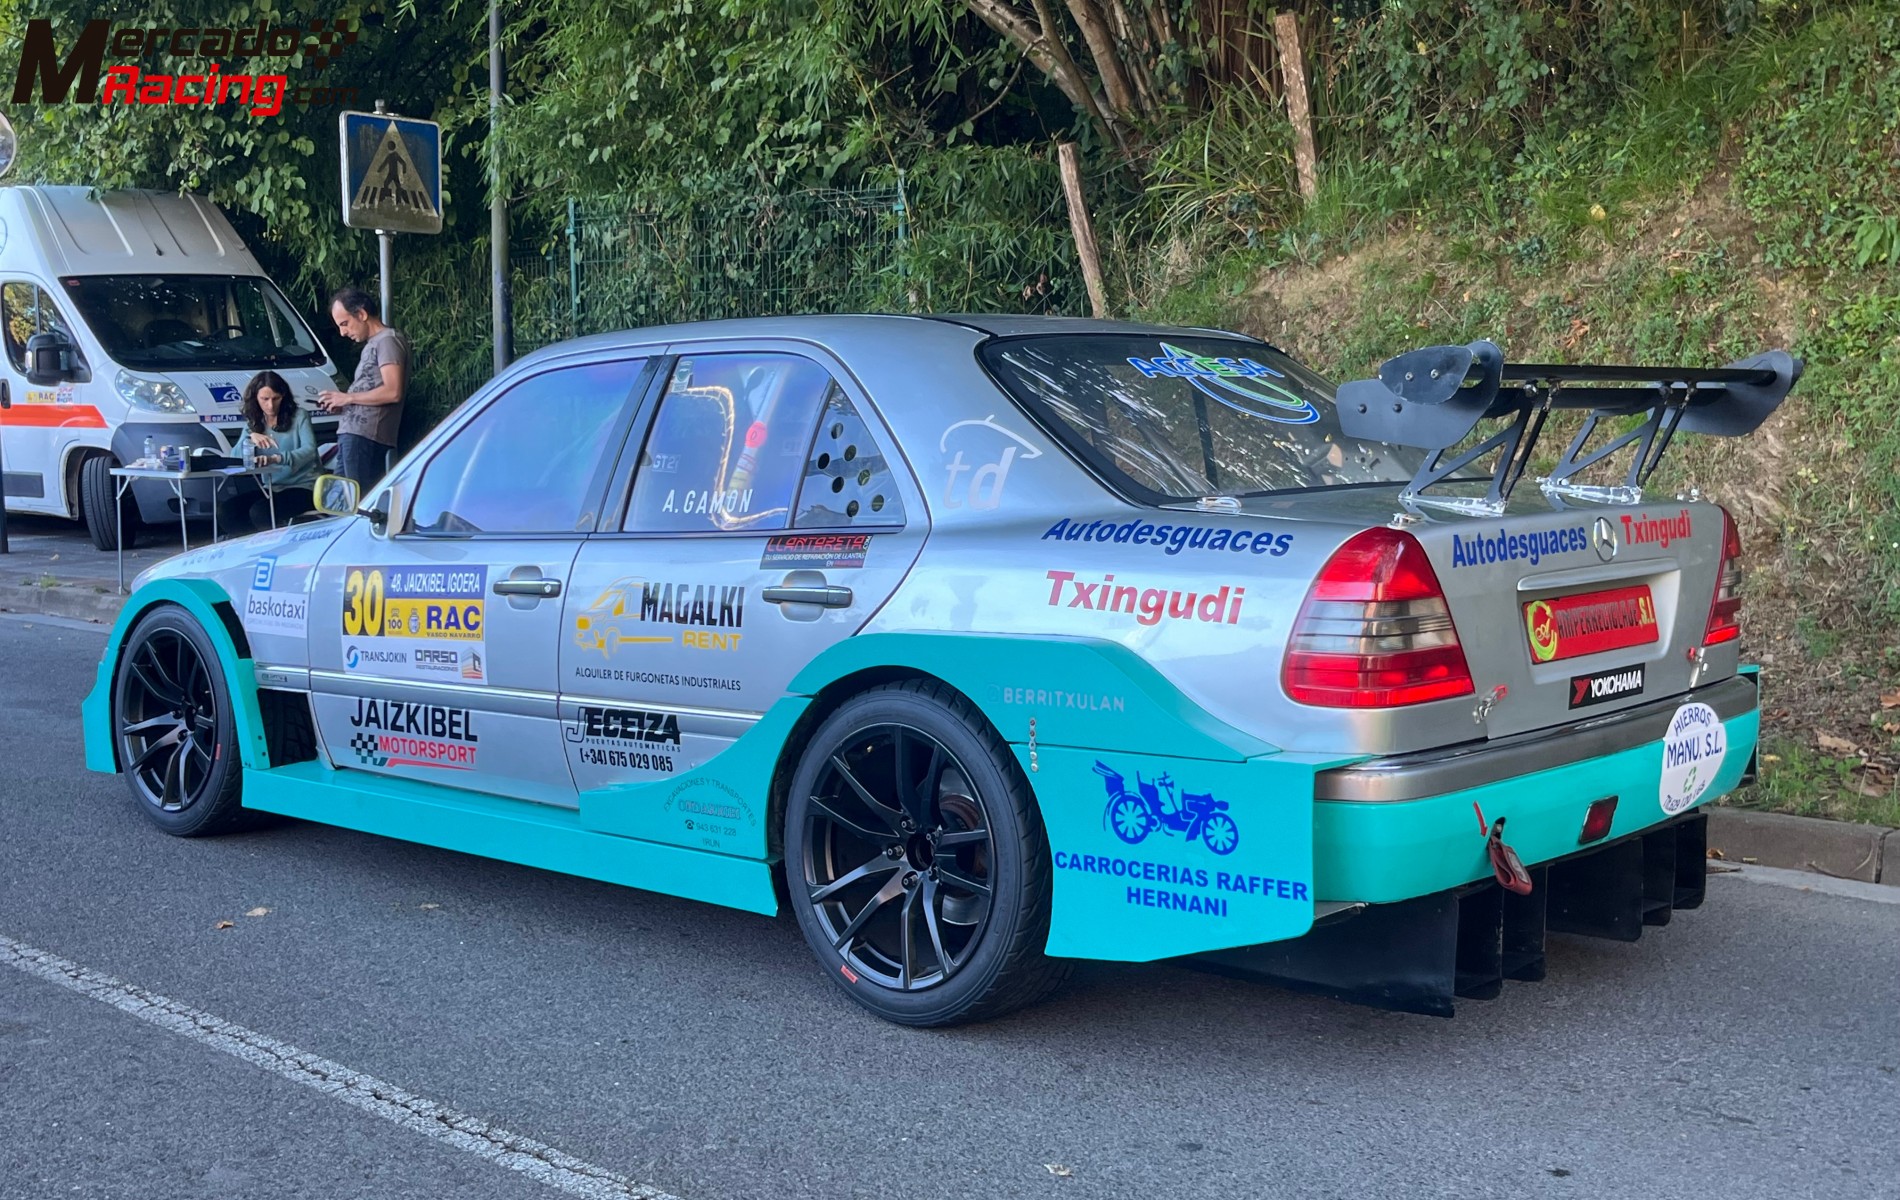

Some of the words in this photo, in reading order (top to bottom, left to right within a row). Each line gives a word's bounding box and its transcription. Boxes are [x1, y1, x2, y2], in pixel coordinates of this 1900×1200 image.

[1126, 356, 1286, 379] ACCESA
[767, 535, 866, 552] LLANTARETA
[1042, 517, 1295, 557] Autodesguaces
[1620, 509, 1692, 549] Txingudi
[1452, 526, 1587, 568] Autodesguaces
[391, 573, 403, 592] 48.
[404, 573, 447, 592] JAIZKIBEL
[447, 573, 480, 592] IGOERA
[248, 594, 306, 620] baskotaxi
[344, 569, 384, 637] 30
[640, 582, 745, 628] MAGALKI
[1046, 570, 1246, 626] Txingudi
[388, 618, 403, 629] 100
[427, 605, 481, 631] RAC
[682, 631, 743, 651] RENT
[360, 650, 408, 664] TRANSJOKIN
[575, 667, 613, 681] ALQUILER
[614, 670, 625, 681] DE
[625, 670, 680, 686] FURGONETAS
[681, 676, 741, 691] INDUSTRIALES
[1590, 669, 1642, 699] YOKOHAMA
[1003, 687, 1125, 712] BERRITXULAN
[350, 696, 478, 742] JAIZKIBEL
[1673, 706, 1712, 737] HIERROS
[378, 735, 477, 764] MOTORSPORT
[586, 738, 621, 747] PUERTAS
[609, 750, 628, 768] 675
[629, 752, 650, 770] 029
[652, 754, 674, 773] 085
[663, 777, 705, 813] EXCAVACIONES
[711, 779, 758, 828] TRANSPORTES
[696, 822, 709, 832] 943
[1054, 851, 1210, 888] CARROCERIAS
[1216, 871, 1308, 902] RAFFER
[1126, 887, 1228, 918] HERNANI
